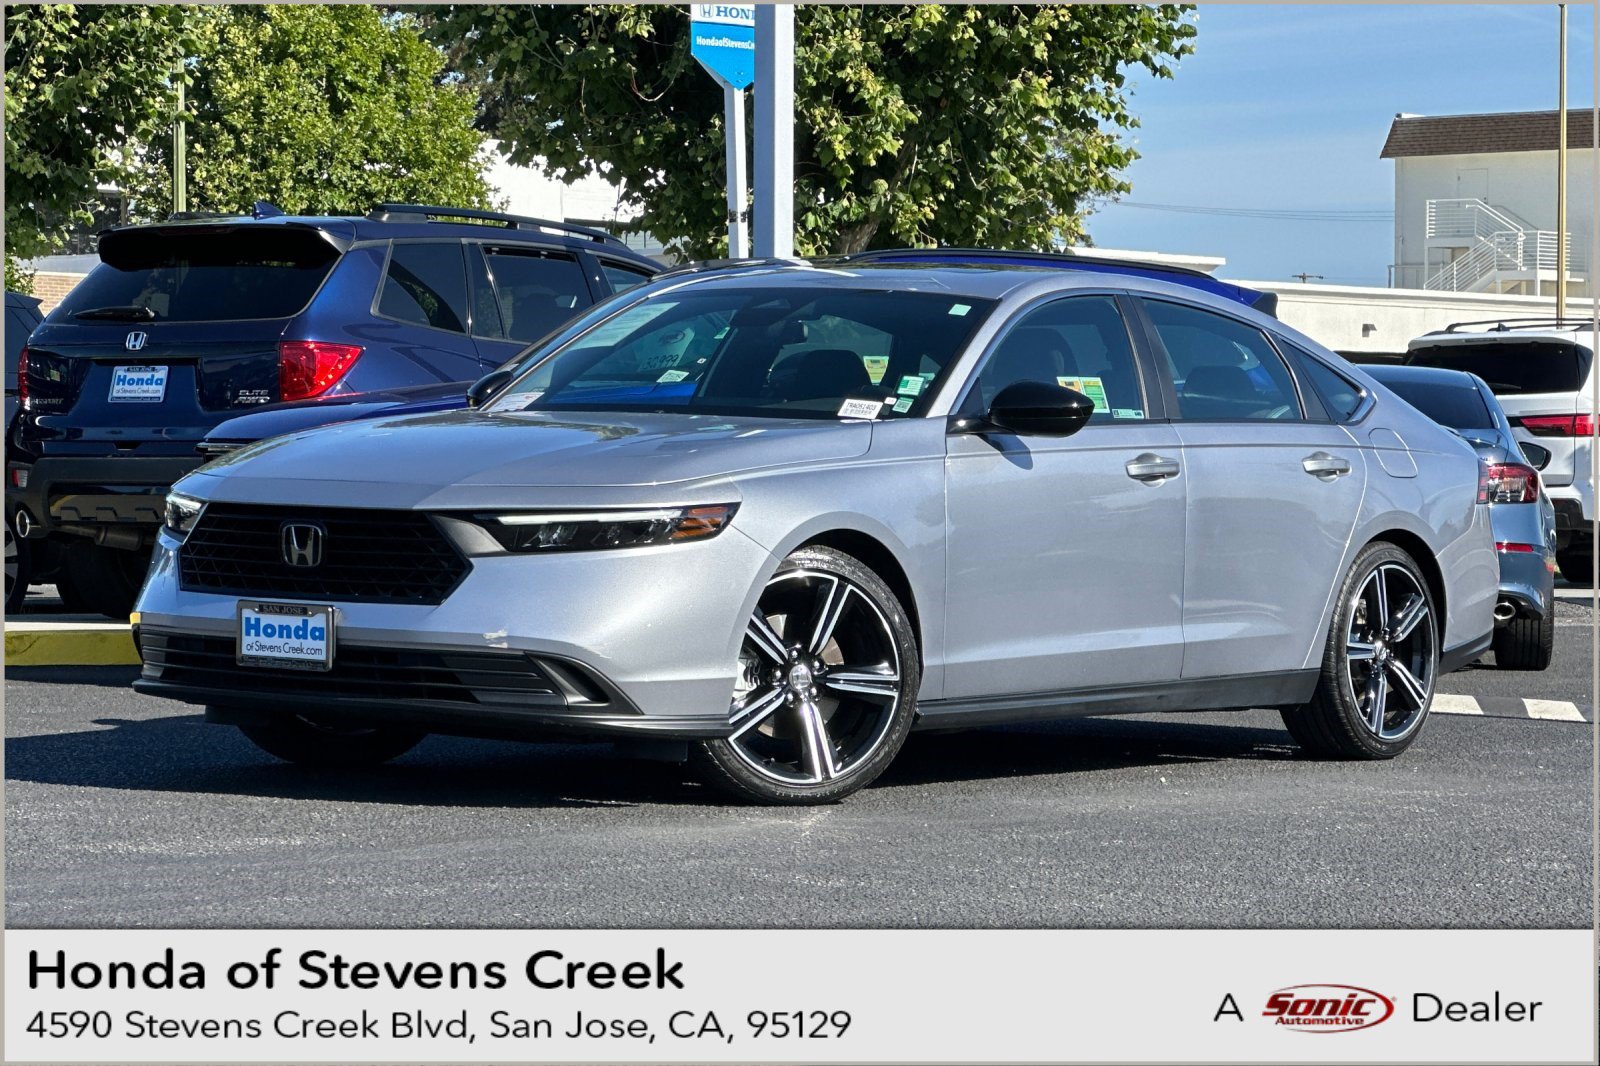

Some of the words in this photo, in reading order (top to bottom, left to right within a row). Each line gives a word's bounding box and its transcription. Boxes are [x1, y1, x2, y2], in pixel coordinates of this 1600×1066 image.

[116, 374, 164, 386] Honda
[263, 605, 279, 613] SAN
[282, 606, 304, 615] JOSE
[245, 617, 325, 641] Honda
[246, 643, 254, 652] of
[254, 640, 282, 653] Stevens
[282, 642, 323, 656] Creek.com
